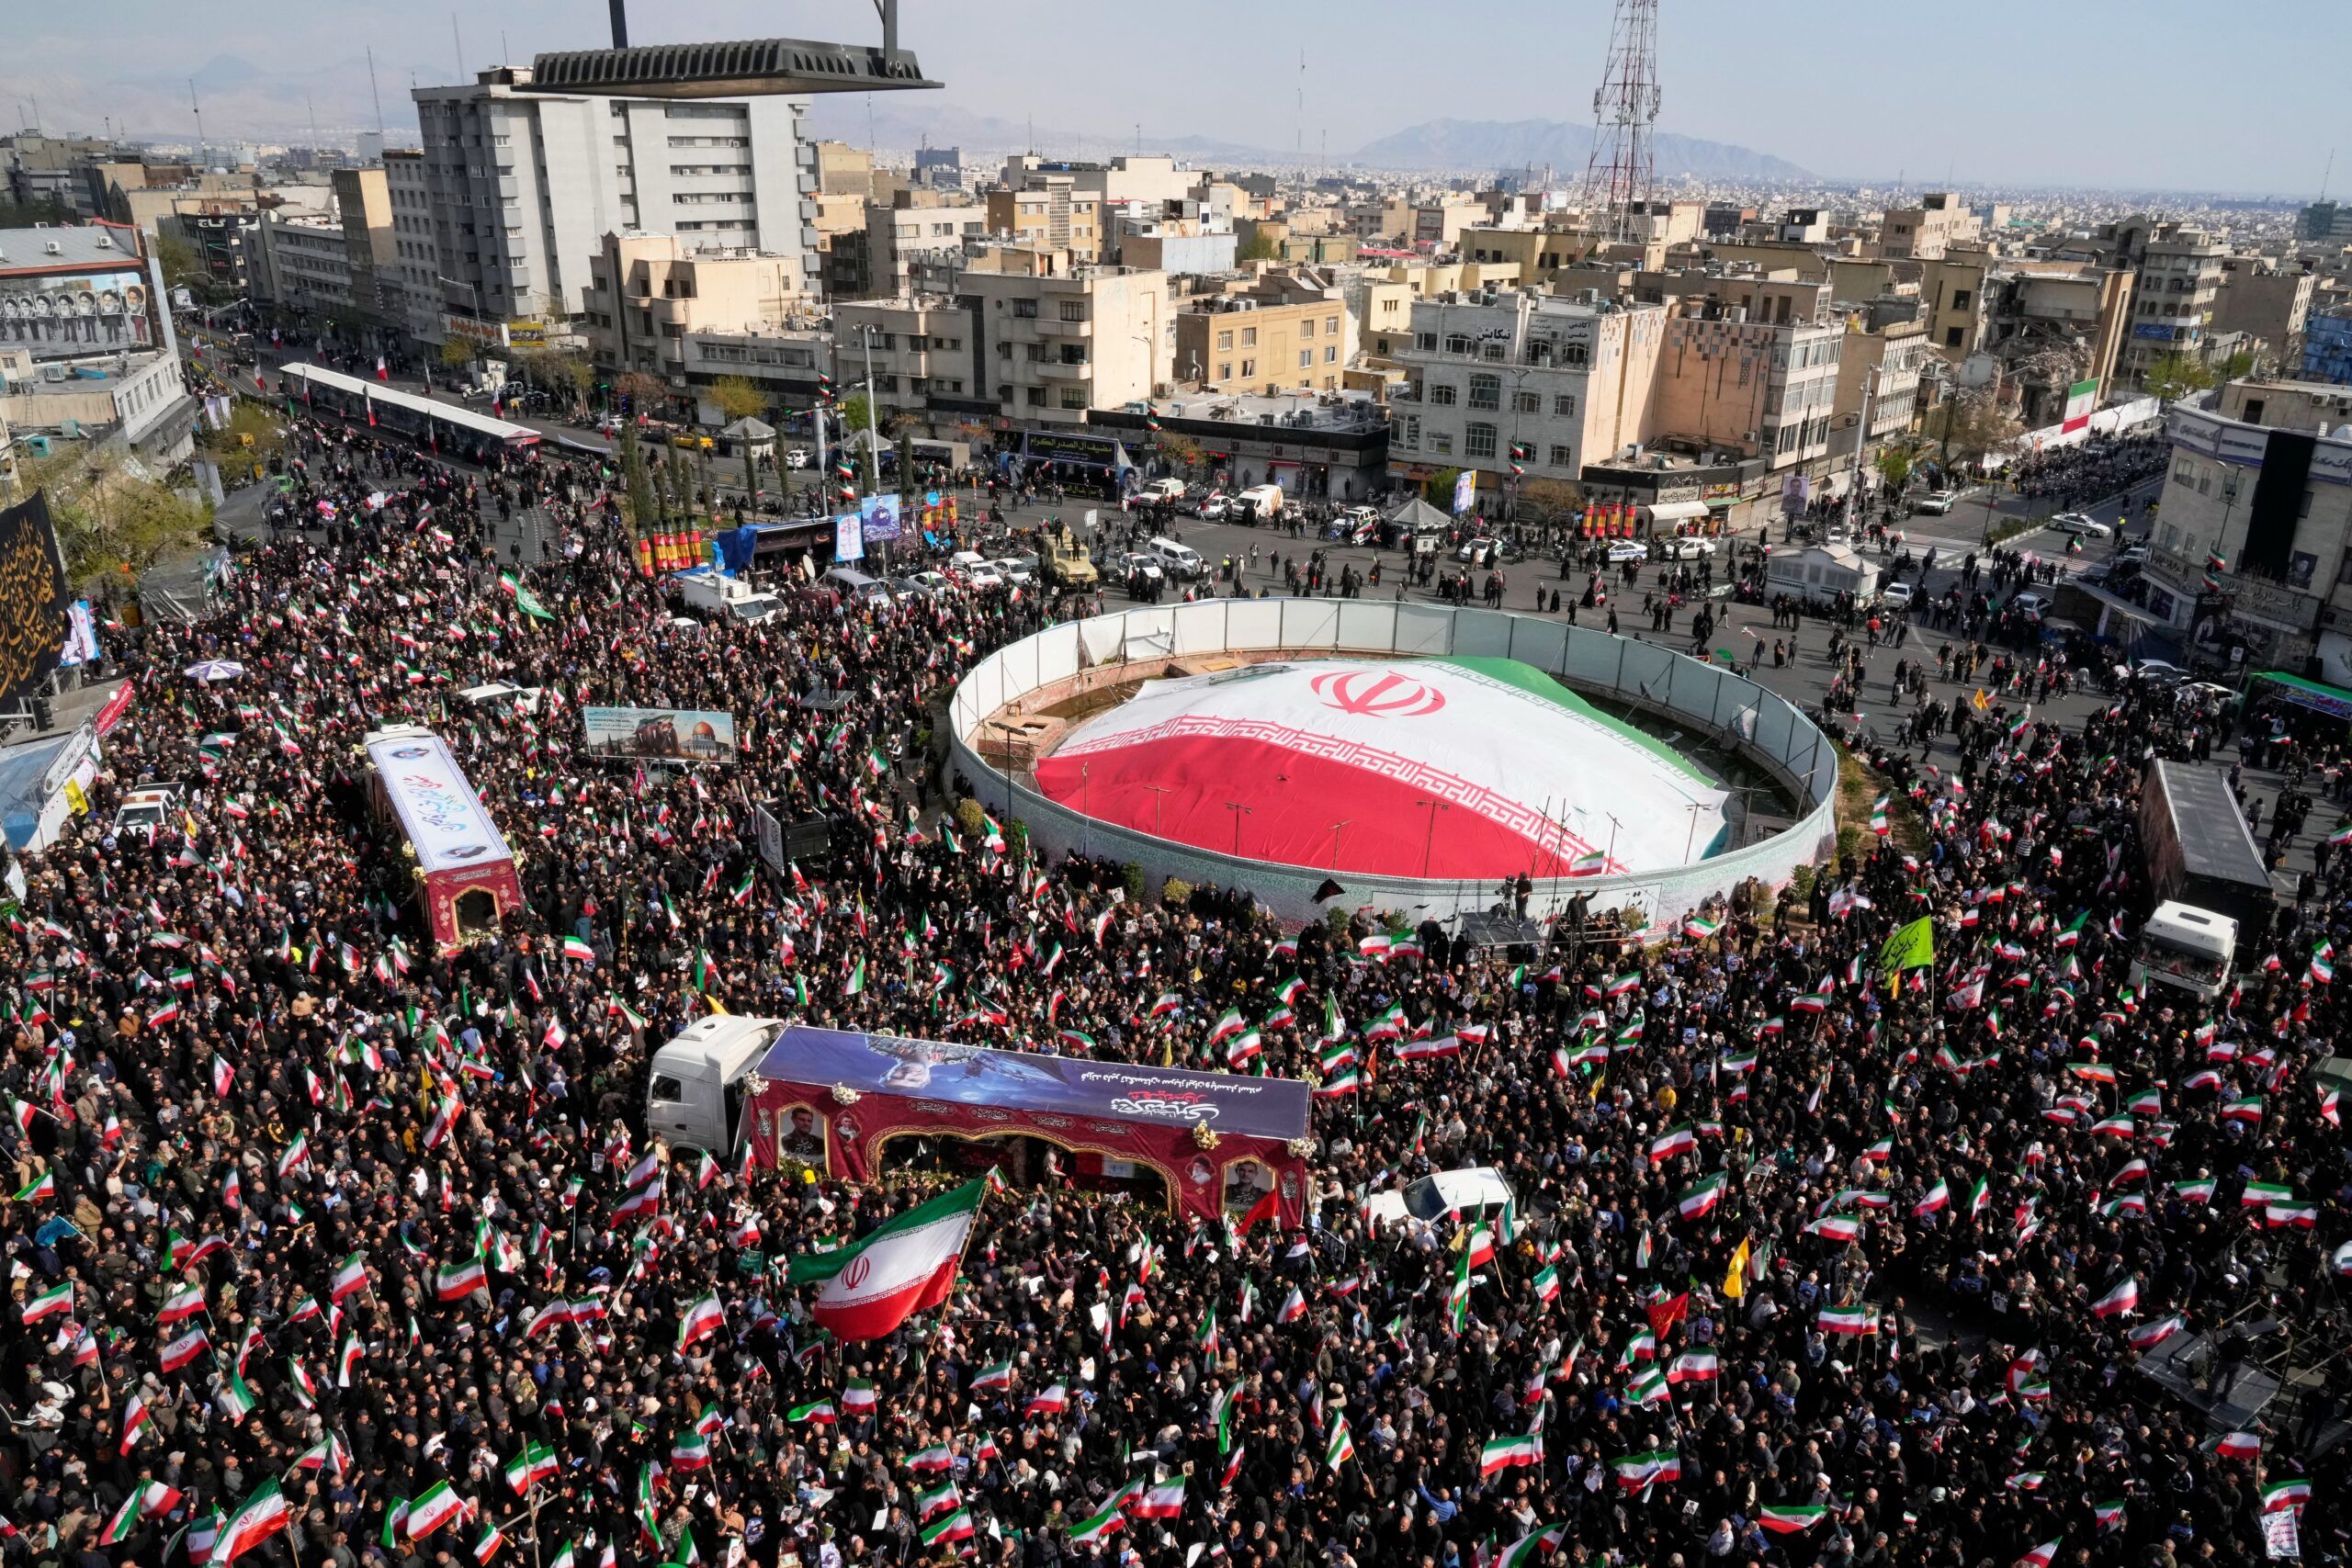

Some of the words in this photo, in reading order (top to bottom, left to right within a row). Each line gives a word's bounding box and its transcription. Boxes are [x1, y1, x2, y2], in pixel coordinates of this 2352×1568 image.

[1081, 1072, 1102, 1081] فرزند
[1103, 1073, 1119, 1082] دلیر
[1162, 1078, 1185, 1089] سرباز
[1186, 1079, 1204, 1089] ایران
[1211, 1080, 1238, 1092] پاسدار
[1238, 1085, 1262, 1094] اسلام
